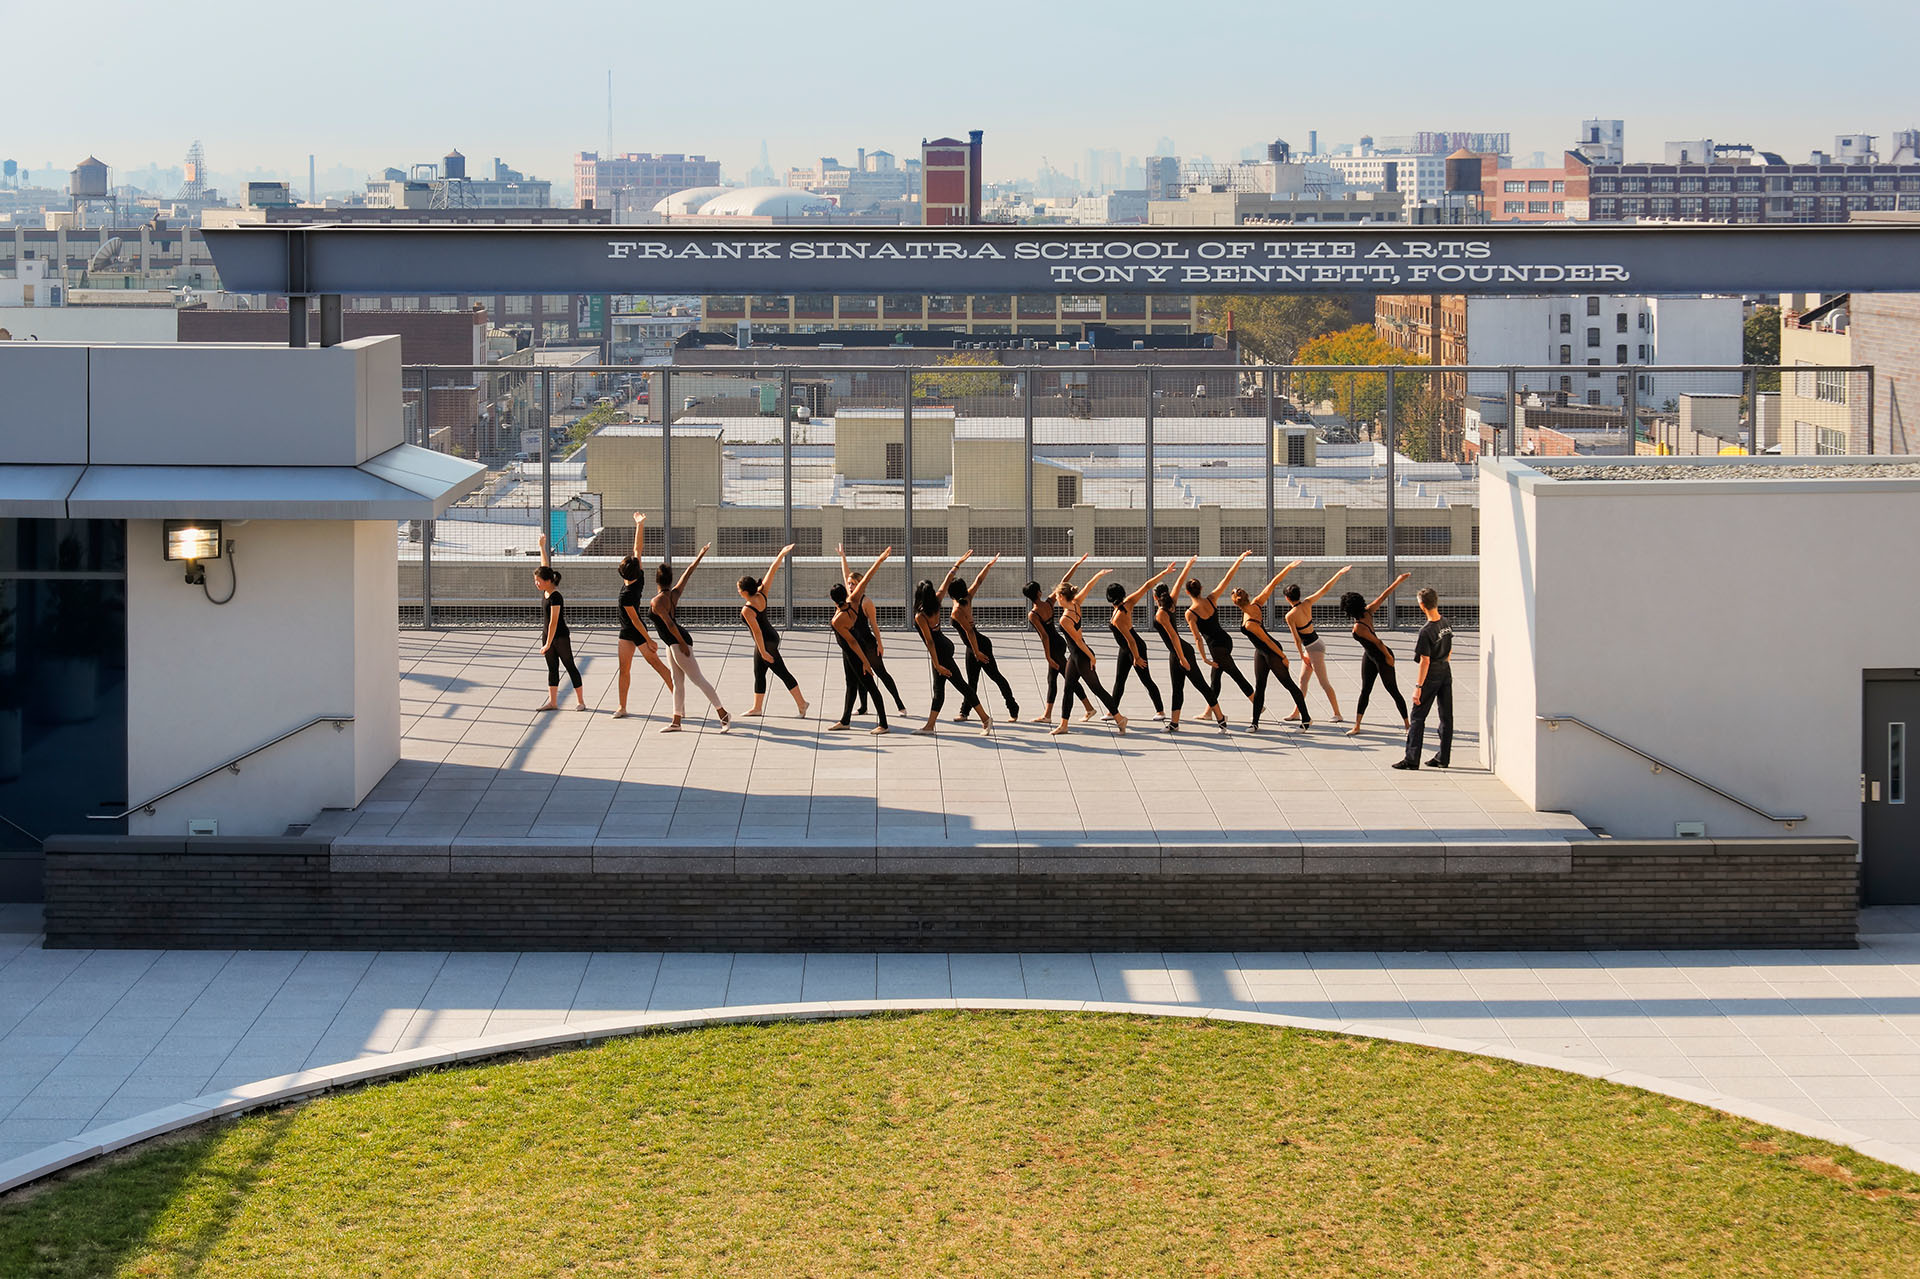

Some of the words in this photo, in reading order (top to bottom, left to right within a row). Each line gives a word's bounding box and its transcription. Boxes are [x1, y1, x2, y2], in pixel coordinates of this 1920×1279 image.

[608, 242, 781, 258] FRANK
[790, 242, 1006, 259] SINATRA
[1015, 242, 1189, 259] SCHOOL
[1198, 242, 1255, 259] OF
[1264, 242, 1355, 259] THE
[1364, 242, 1491, 259] ARTS
[1051, 265, 1173, 282] TONY
[1181, 265, 1401, 285] BENNETT,
[1408, 265, 1630, 282] FOUNDER
